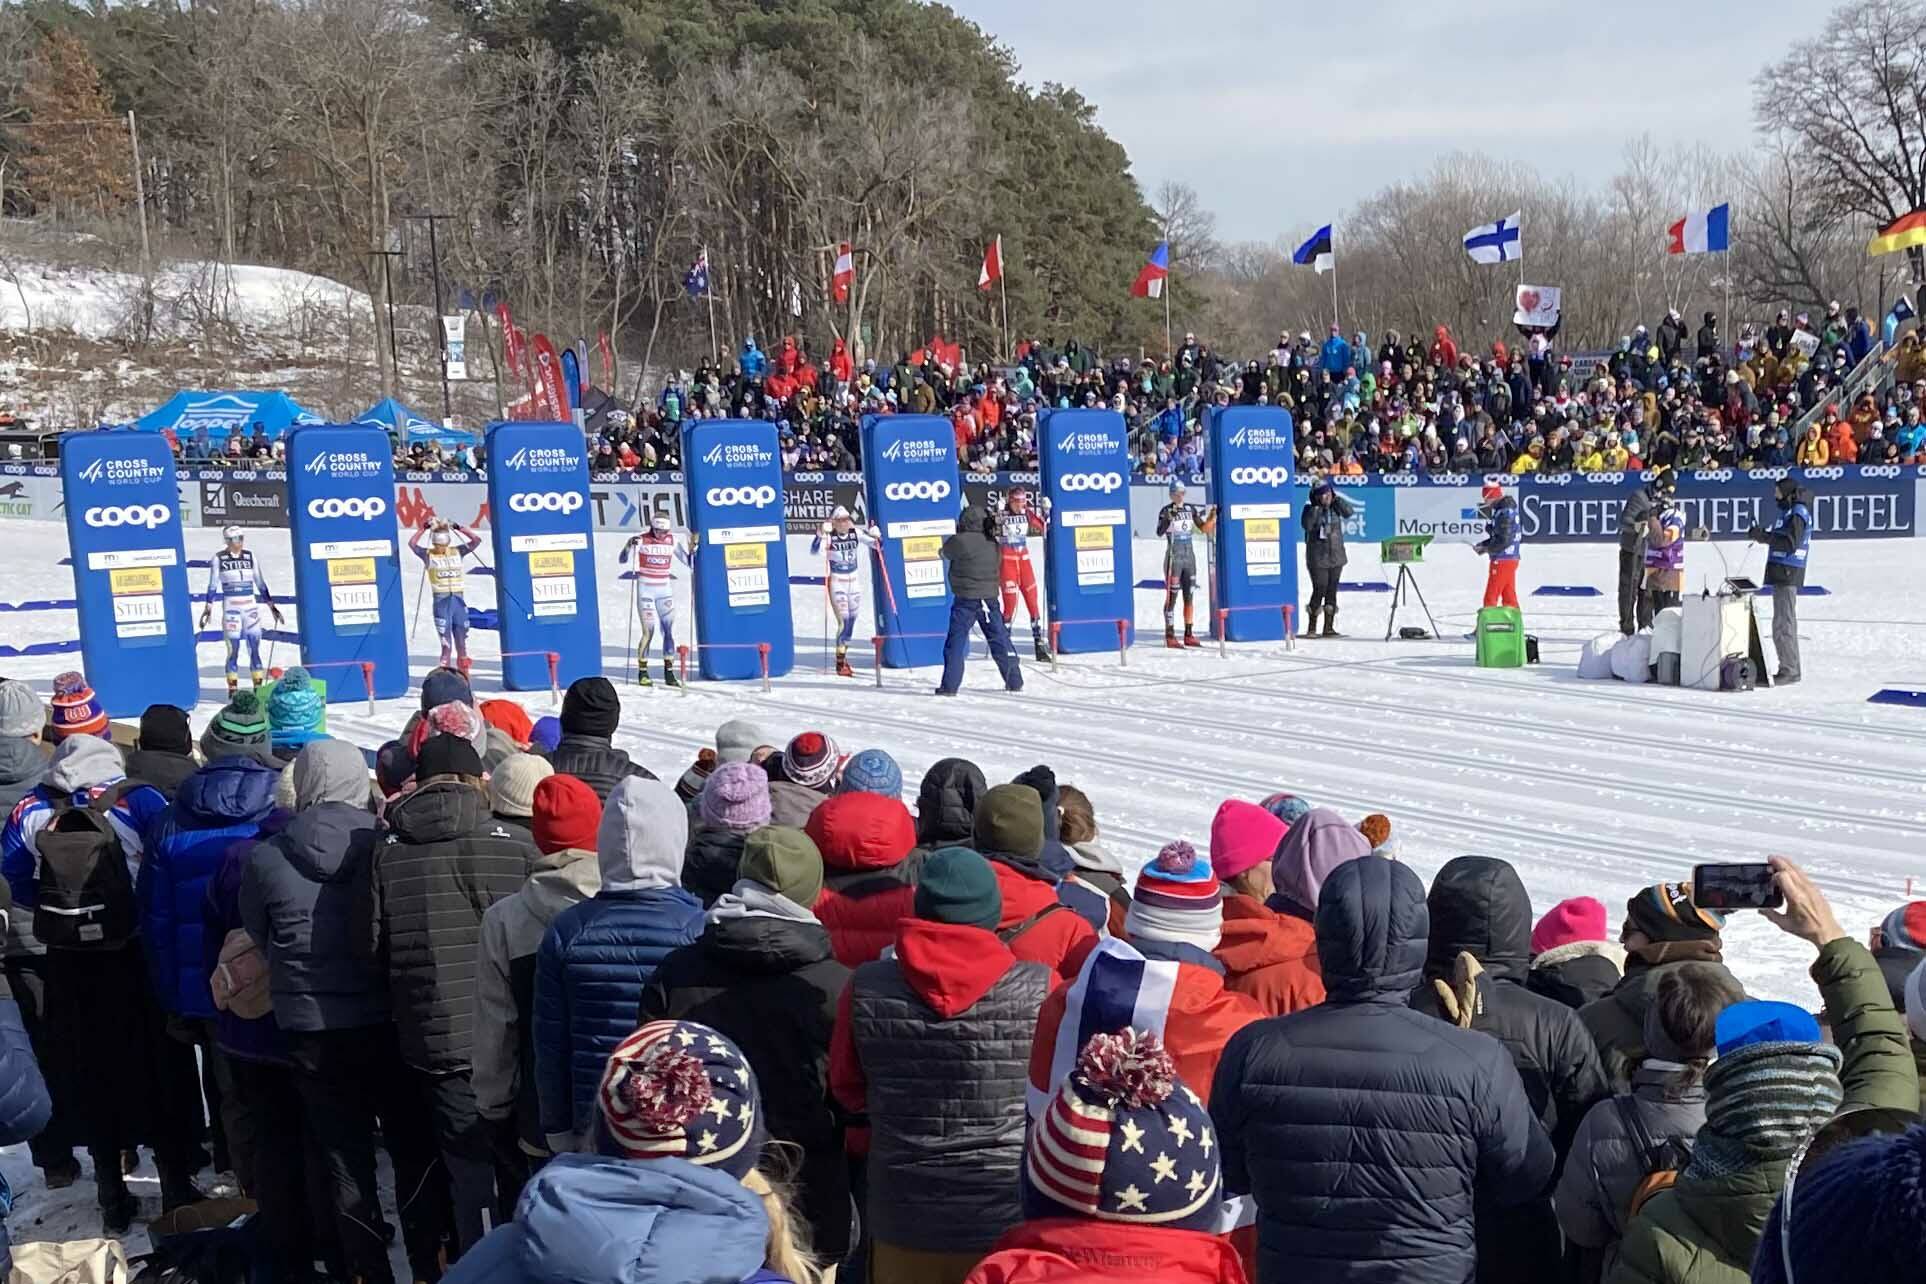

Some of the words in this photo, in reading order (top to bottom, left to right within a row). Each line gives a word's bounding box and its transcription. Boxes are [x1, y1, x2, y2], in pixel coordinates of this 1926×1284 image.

[1078, 433, 1108, 442] CROSS
[1248, 428, 1276, 437] CROSS
[903, 440, 936, 449] CROSS
[1078, 441, 1120, 450] COUNTRY
[1248, 436, 1286, 444] COUNTRY
[529, 449, 566, 458] CROSS
[724, 444, 759, 453] CROSS
[904, 448, 948, 458] COUNTRY
[330, 453, 368, 462] CROSS
[530, 457, 580, 466] COUNTRY
[725, 452, 772, 462] COUNTRY
[4, 464, 26, 476] coop
[106, 459, 148, 470] CROSS
[330, 461, 382, 471] COUNTRY
[34, 466, 58, 476] coop
[107, 467, 166, 480] COUNTRY
[176, 470, 190, 480] op
[200, 470, 224, 480] coop
[232, 470, 256, 480] coop
[1694, 470, 1732, 482] coop
[1748, 468, 1788, 480] coop
[1804, 467, 1844, 480] coop
[1860, 466, 1901, 478] coop
[406, 472, 432, 482] coop
[442, 472, 468, 482] coop
[670, 472, 684, 482] co
[794, 472, 824, 482] coop
[966, 472, 997, 484] coop
[1191, 474, 1207, 484] co
[1231, 466, 1288, 488] coop
[1334, 474, 1368, 486] coop
[1382, 474, 1418, 486] coop
[1432, 474, 1468, 486] coop
[1586, 472, 1624, 484] coop
[1060, 472, 1122, 494] coop
[706, 485, 776, 508] coop
[885, 480, 951, 502] coop
[784, 490, 834, 504] SHARE
[16, 503, 32, 514] CAT
[509, 491, 584, 515] coop
[308, 497, 386, 521] coop
[1674, 496, 1772, 533] TIFEL
[1812, 494, 1910, 532] TIFEL
[85, 504, 171, 529] coop
[1522, 494, 1627, 536] STIFE
[1016, 525, 1021, 535] 5
[1182, 520, 1188, 530] 6
[1400, 519, 1484, 535] Mortens
[222, 560, 251, 570] STIFEL
[534, 583, 572, 596] STIFEL
[334, 592, 376, 605] STIFEL
[116, 602, 160, 617] STIFEL
